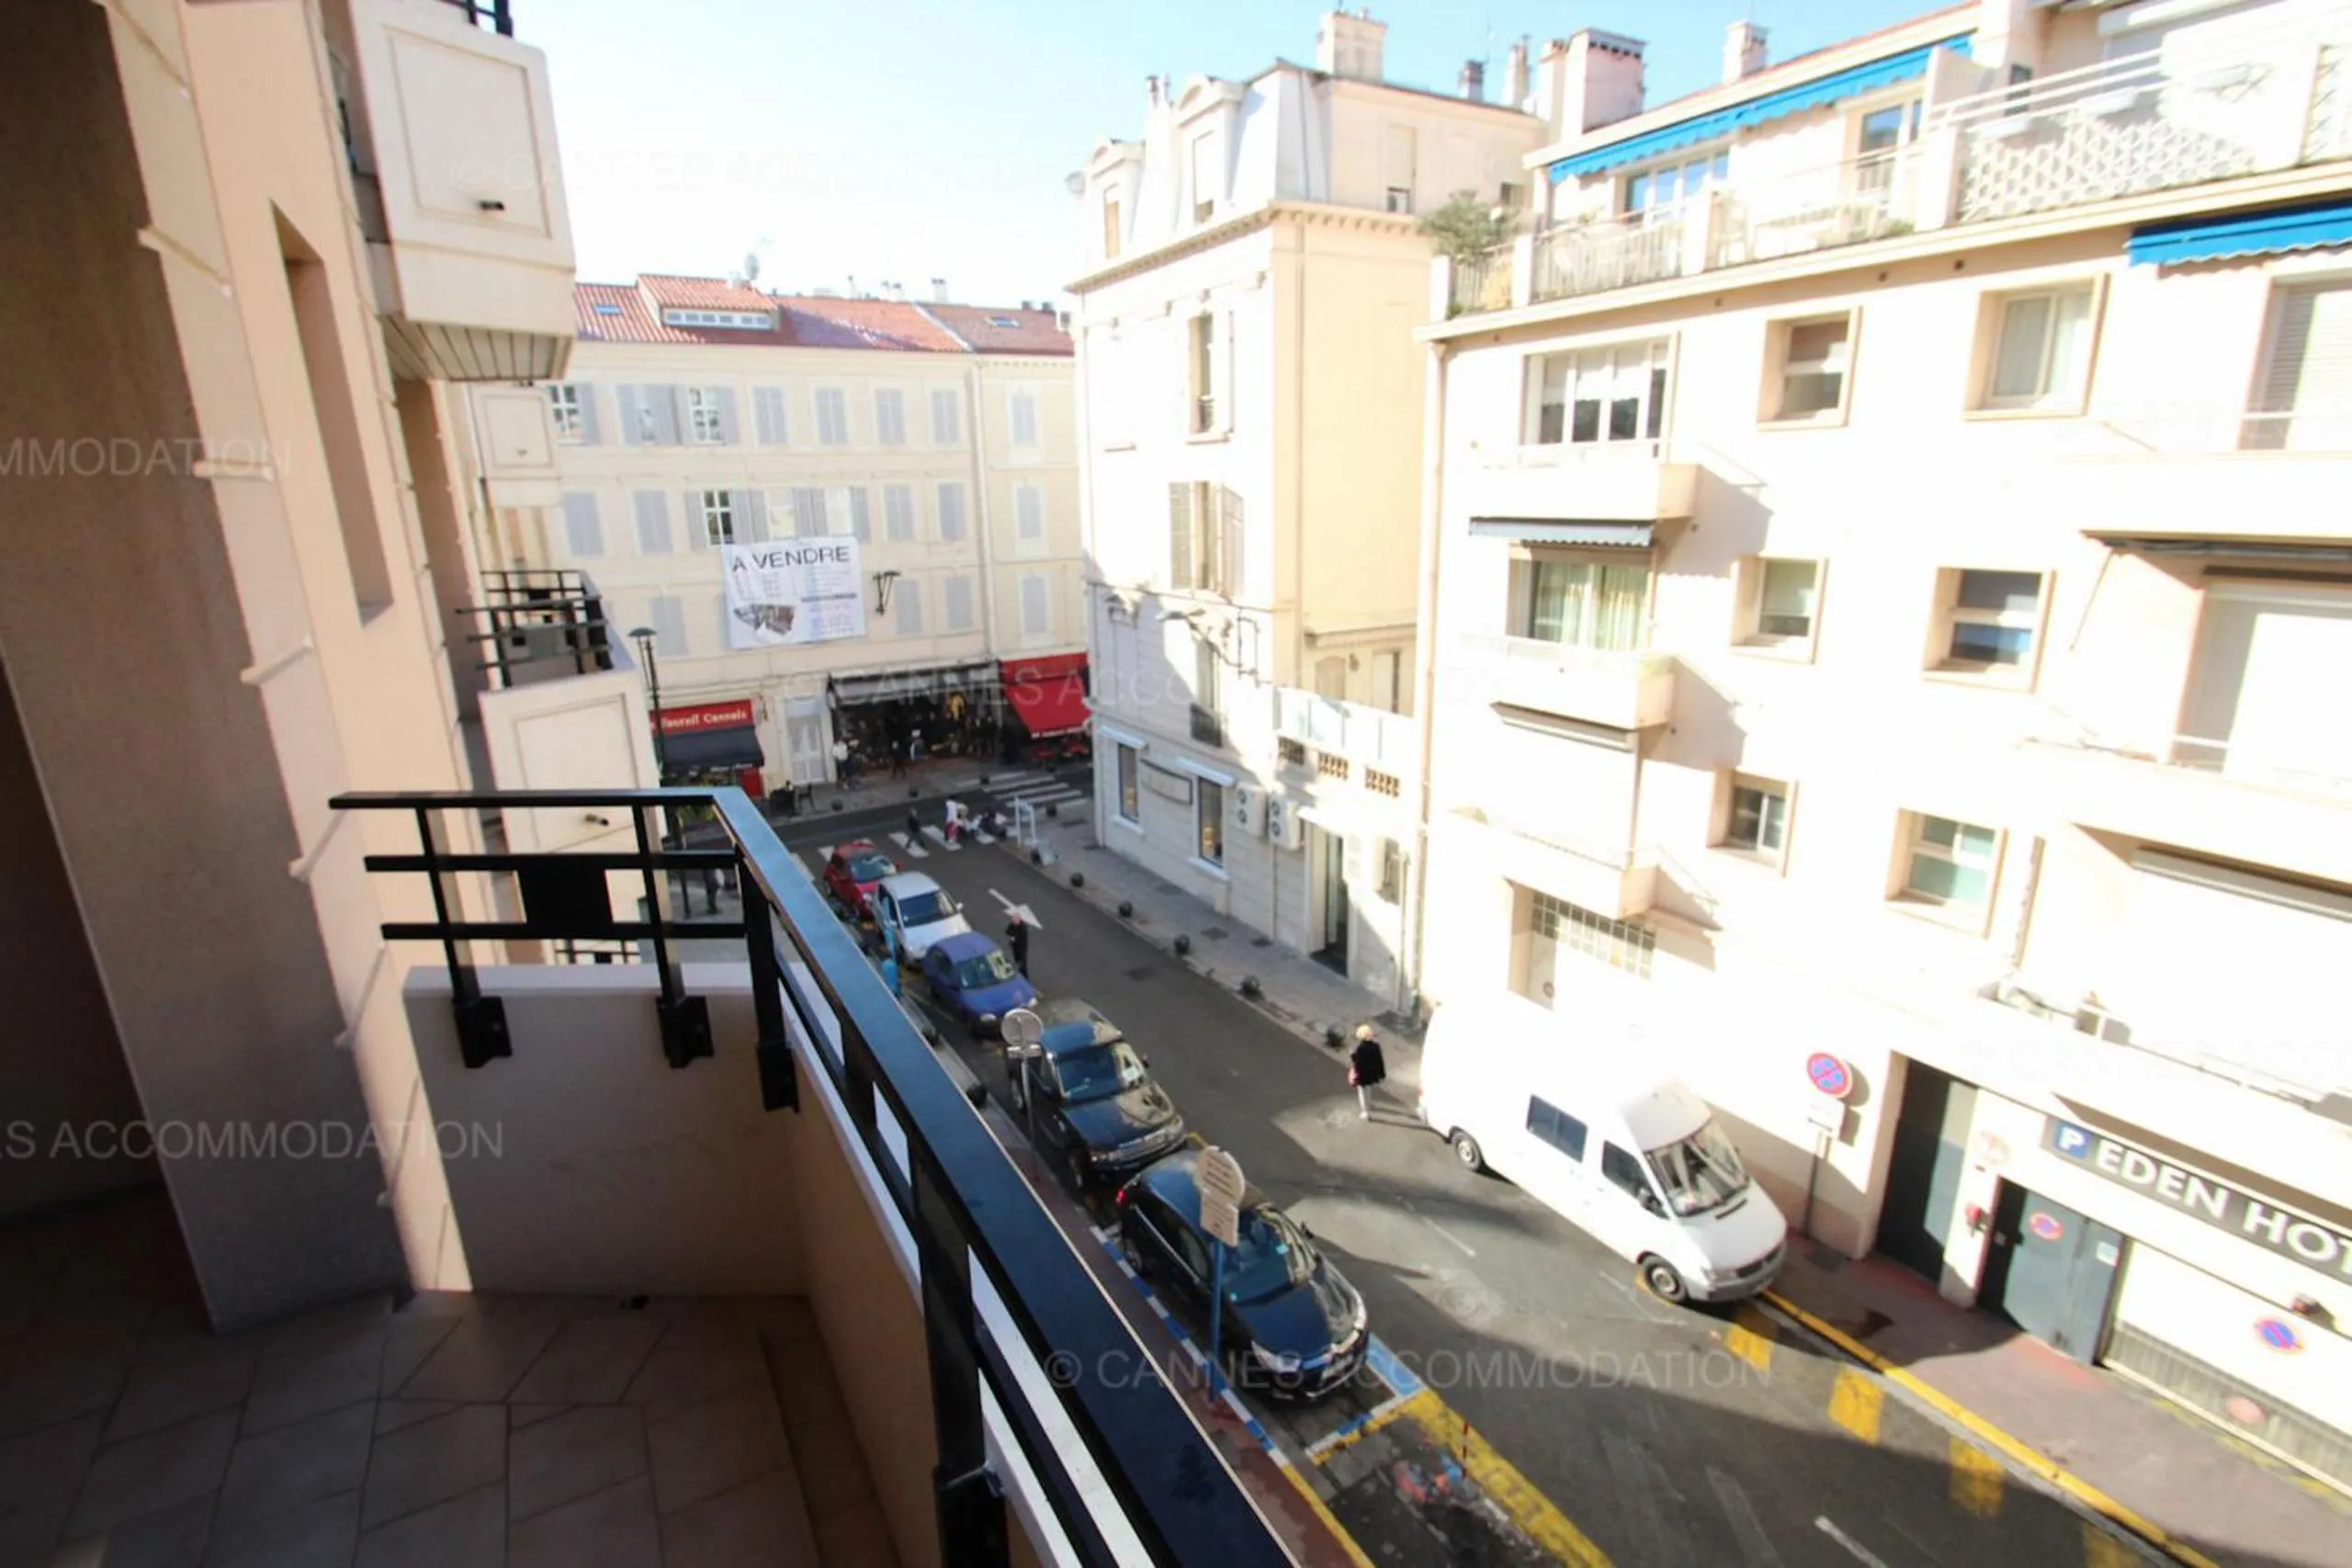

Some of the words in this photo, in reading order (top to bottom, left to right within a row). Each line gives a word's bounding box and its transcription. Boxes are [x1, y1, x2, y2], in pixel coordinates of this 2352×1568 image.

[732, 556, 748, 573] A
[752, 546, 852, 570] VENDRE
[2094, 1138, 2231, 1220] EDEN
